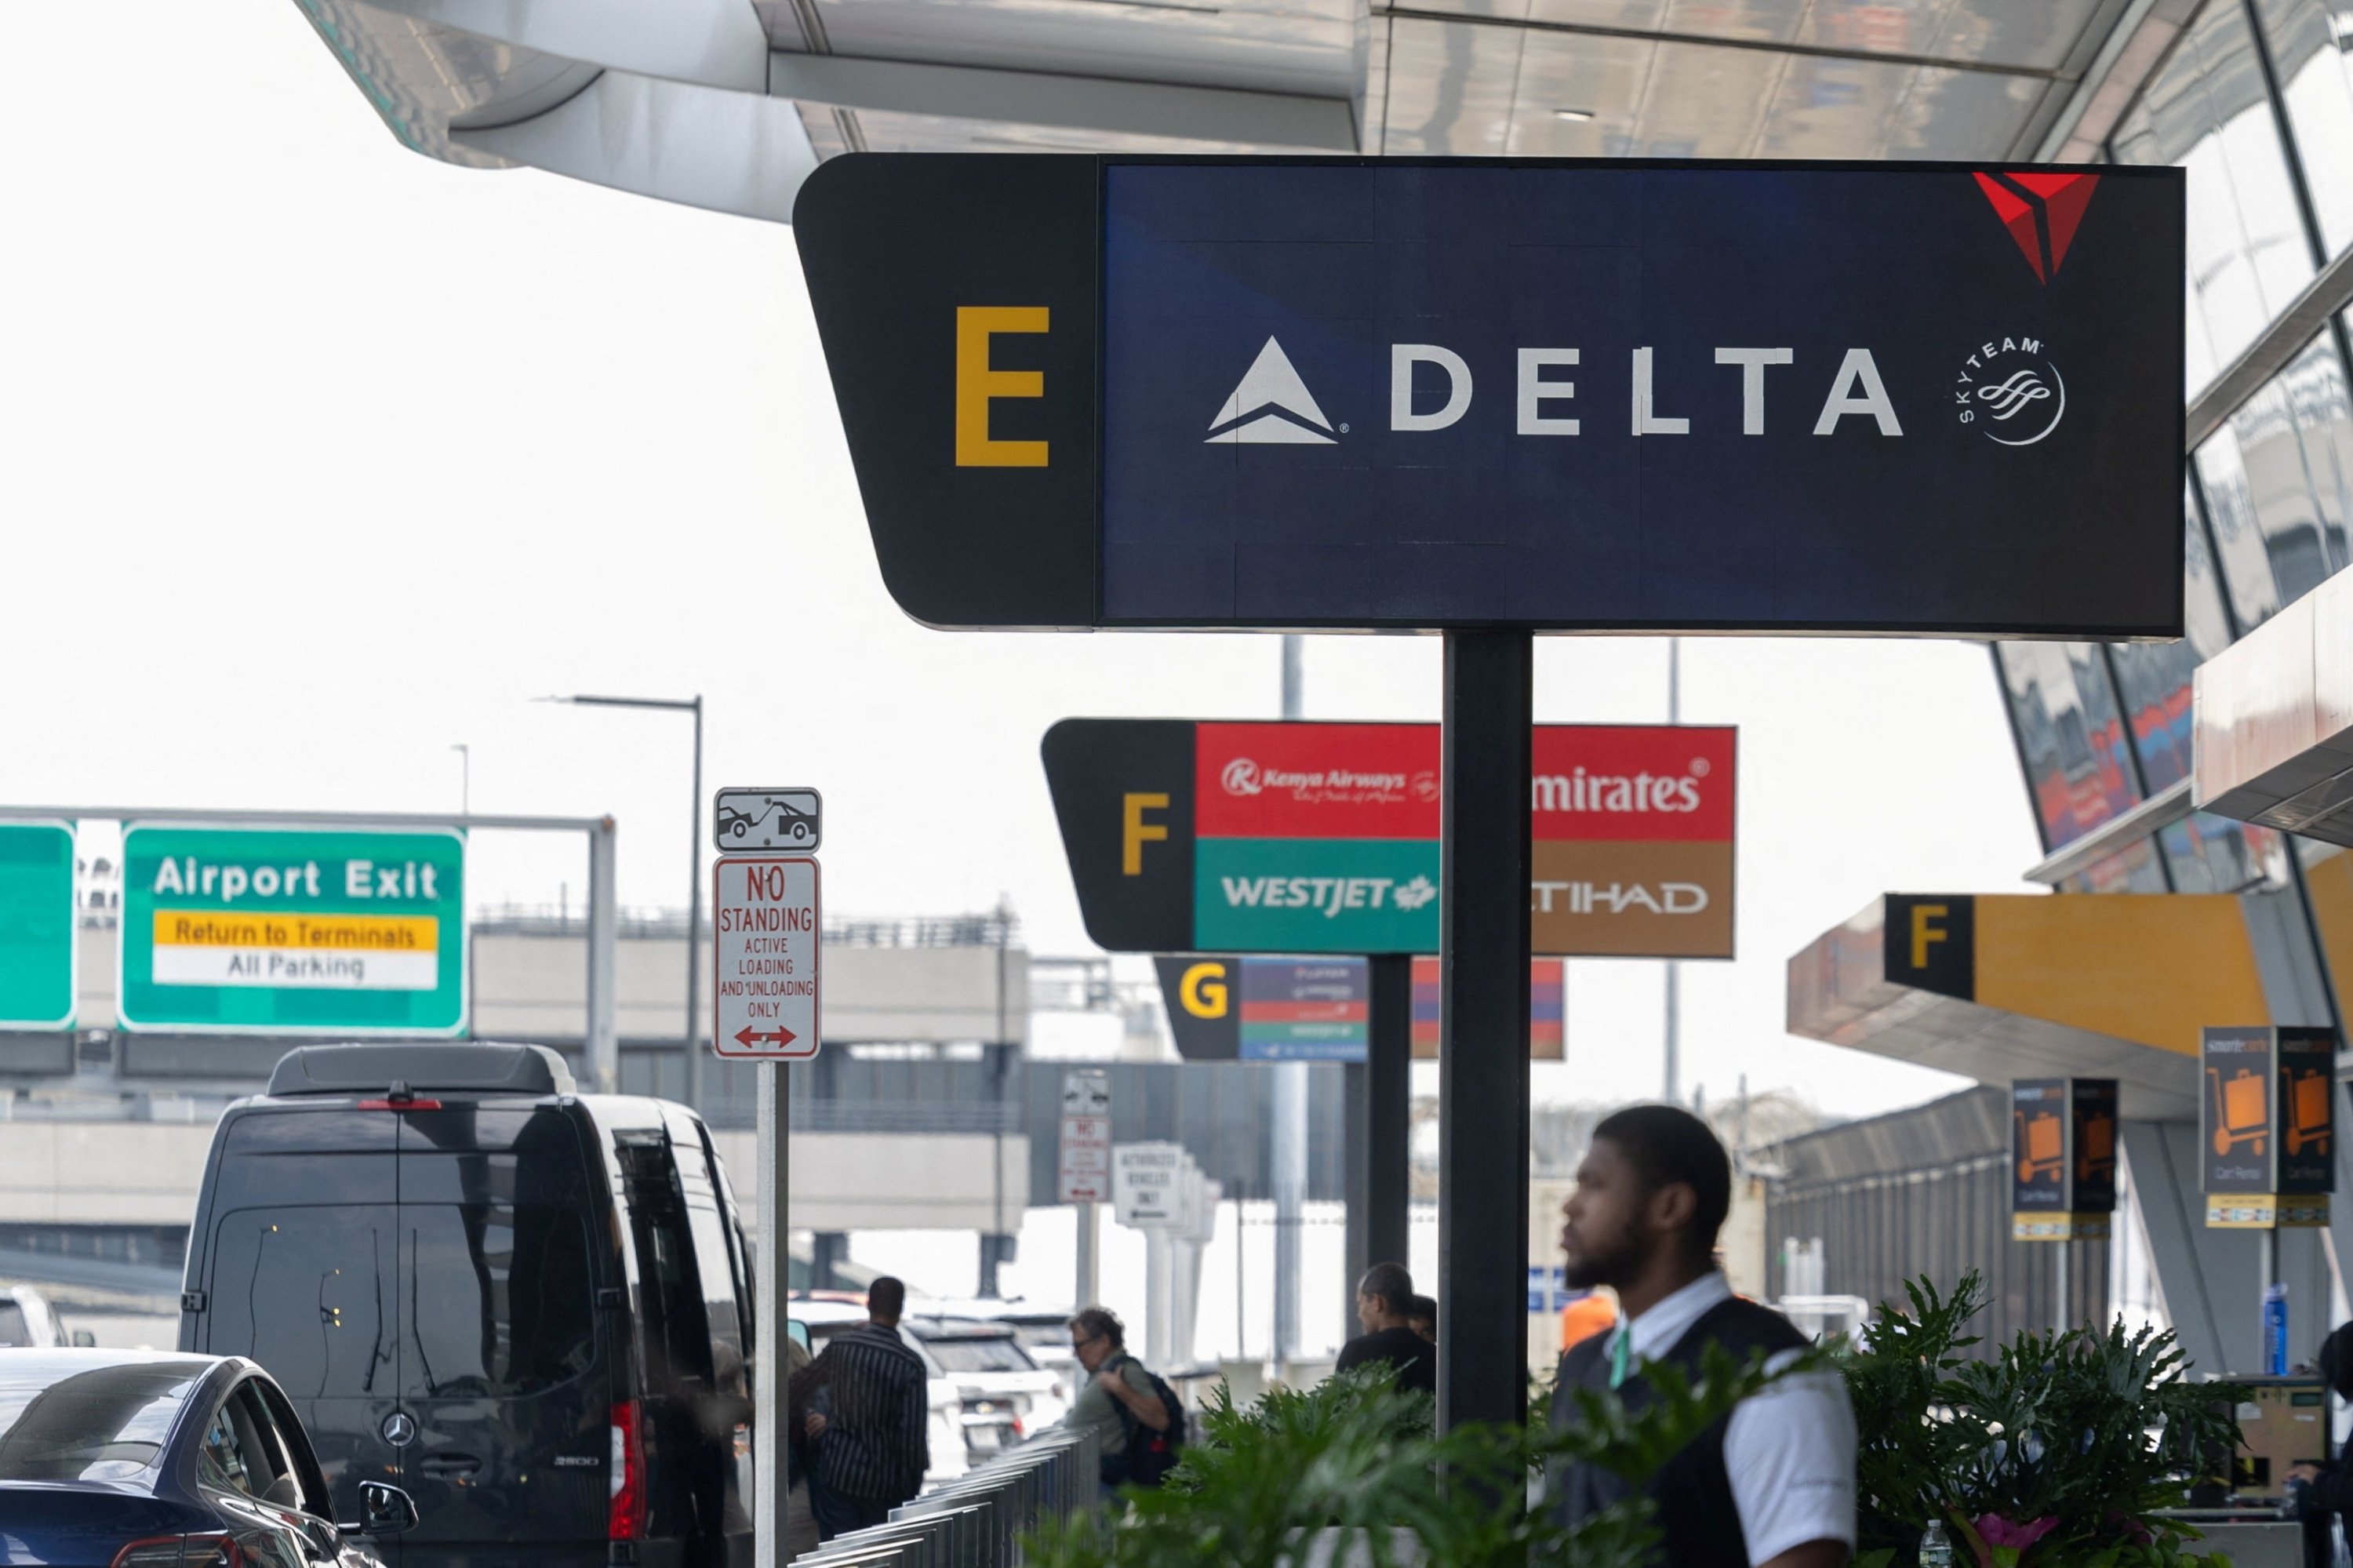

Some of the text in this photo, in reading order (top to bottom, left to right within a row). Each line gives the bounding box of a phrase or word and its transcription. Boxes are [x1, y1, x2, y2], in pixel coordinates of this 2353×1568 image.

[955, 307, 1049, 467] E
[1391, 344, 1904, 436] DELTA
[1956, 337, 2040, 424] SKYTEAM
[1263, 769, 1323, 791] Kenya
[1327, 769, 1406, 791] Airways
[1532, 766, 1700, 812] mirates
[1123, 793, 1169, 875] F
[154, 856, 438, 902] Airport Exit
[747, 866, 785, 901] NO
[1222, 877, 1393, 918] WESTJET
[1532, 881, 1708, 913] TIHAD
[176, 919, 415, 948] Return to Terminals
[721, 908, 813, 932] STANDING
[1911, 905, 1947, 969] F
[744, 938, 788, 953] ACTIVE
[227, 955, 365, 981] All Parking
[739, 959, 794, 975] LOADING
[721, 981, 813, 996] AND UNLOADING
[1180, 962, 1228, 1019] G
[748, 1002, 780, 1018] ONLY
